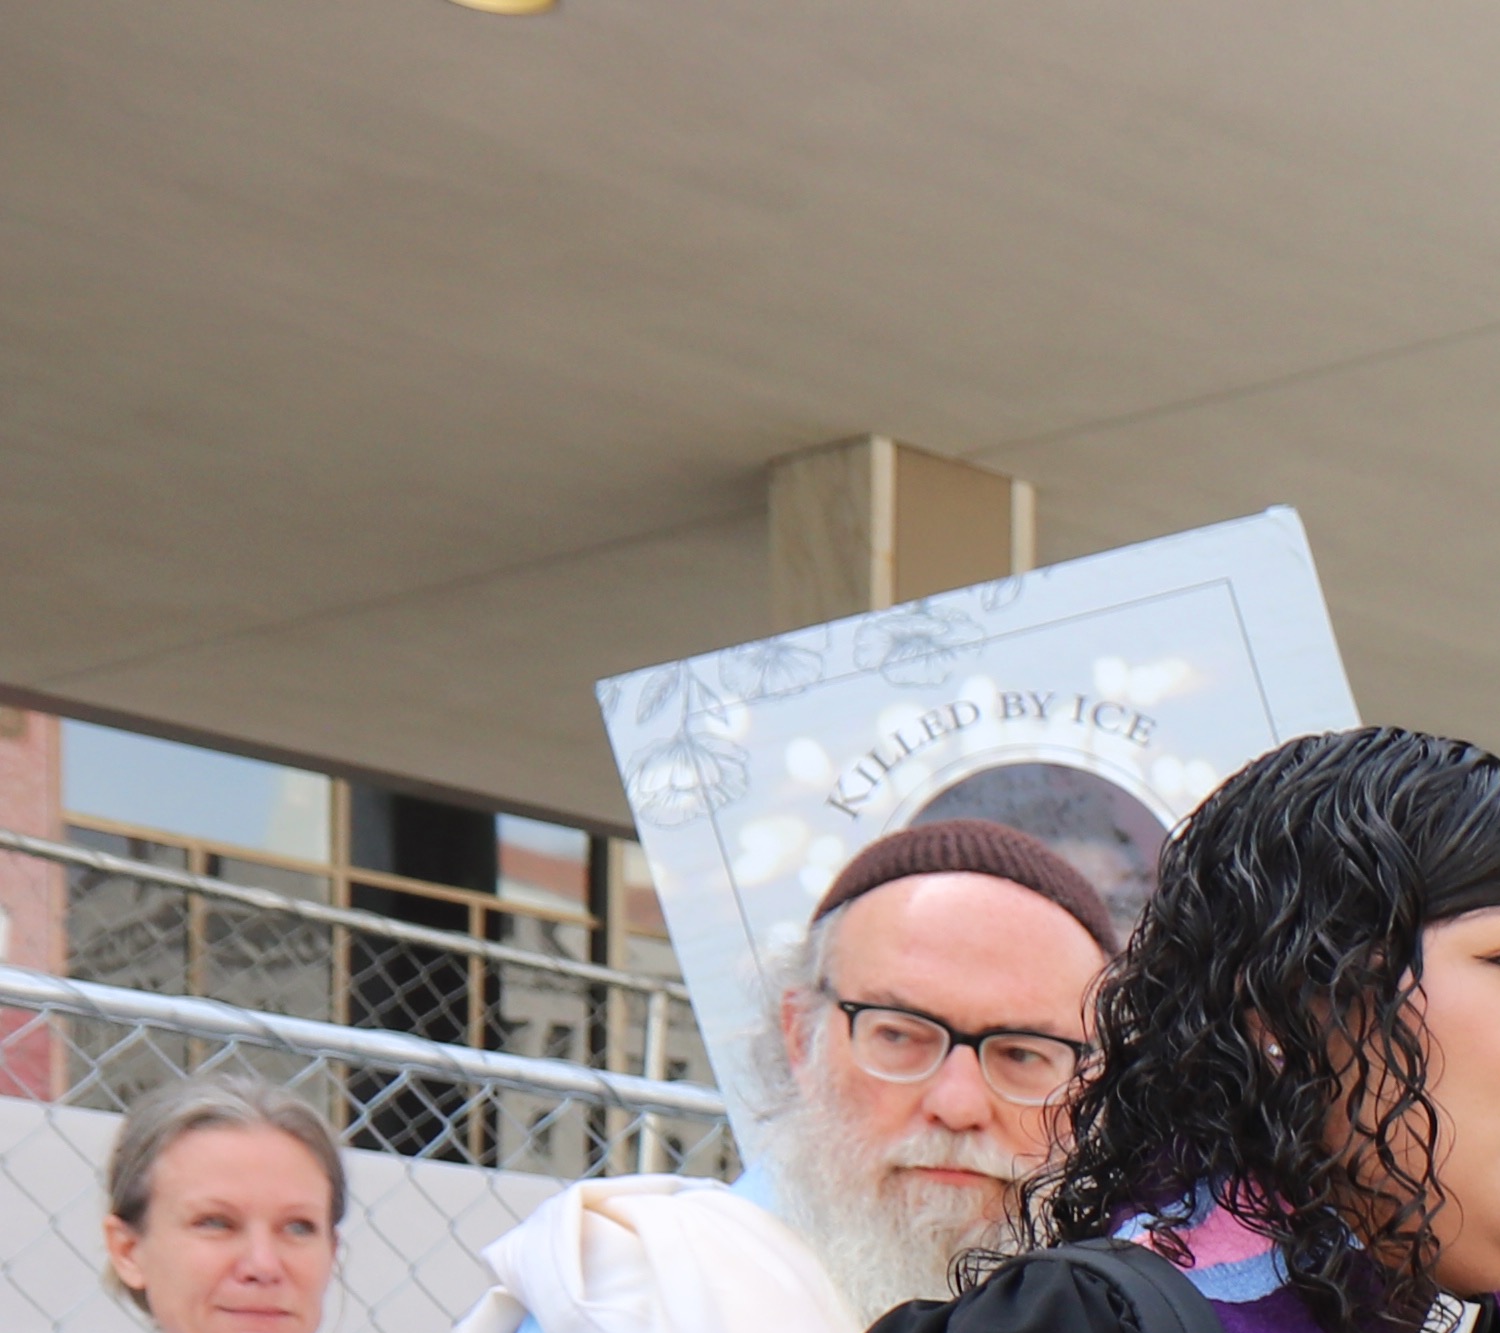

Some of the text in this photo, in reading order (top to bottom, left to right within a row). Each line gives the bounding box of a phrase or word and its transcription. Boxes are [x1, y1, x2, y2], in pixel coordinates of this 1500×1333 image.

[824, 691, 1157, 819] KILLED BY ICE
